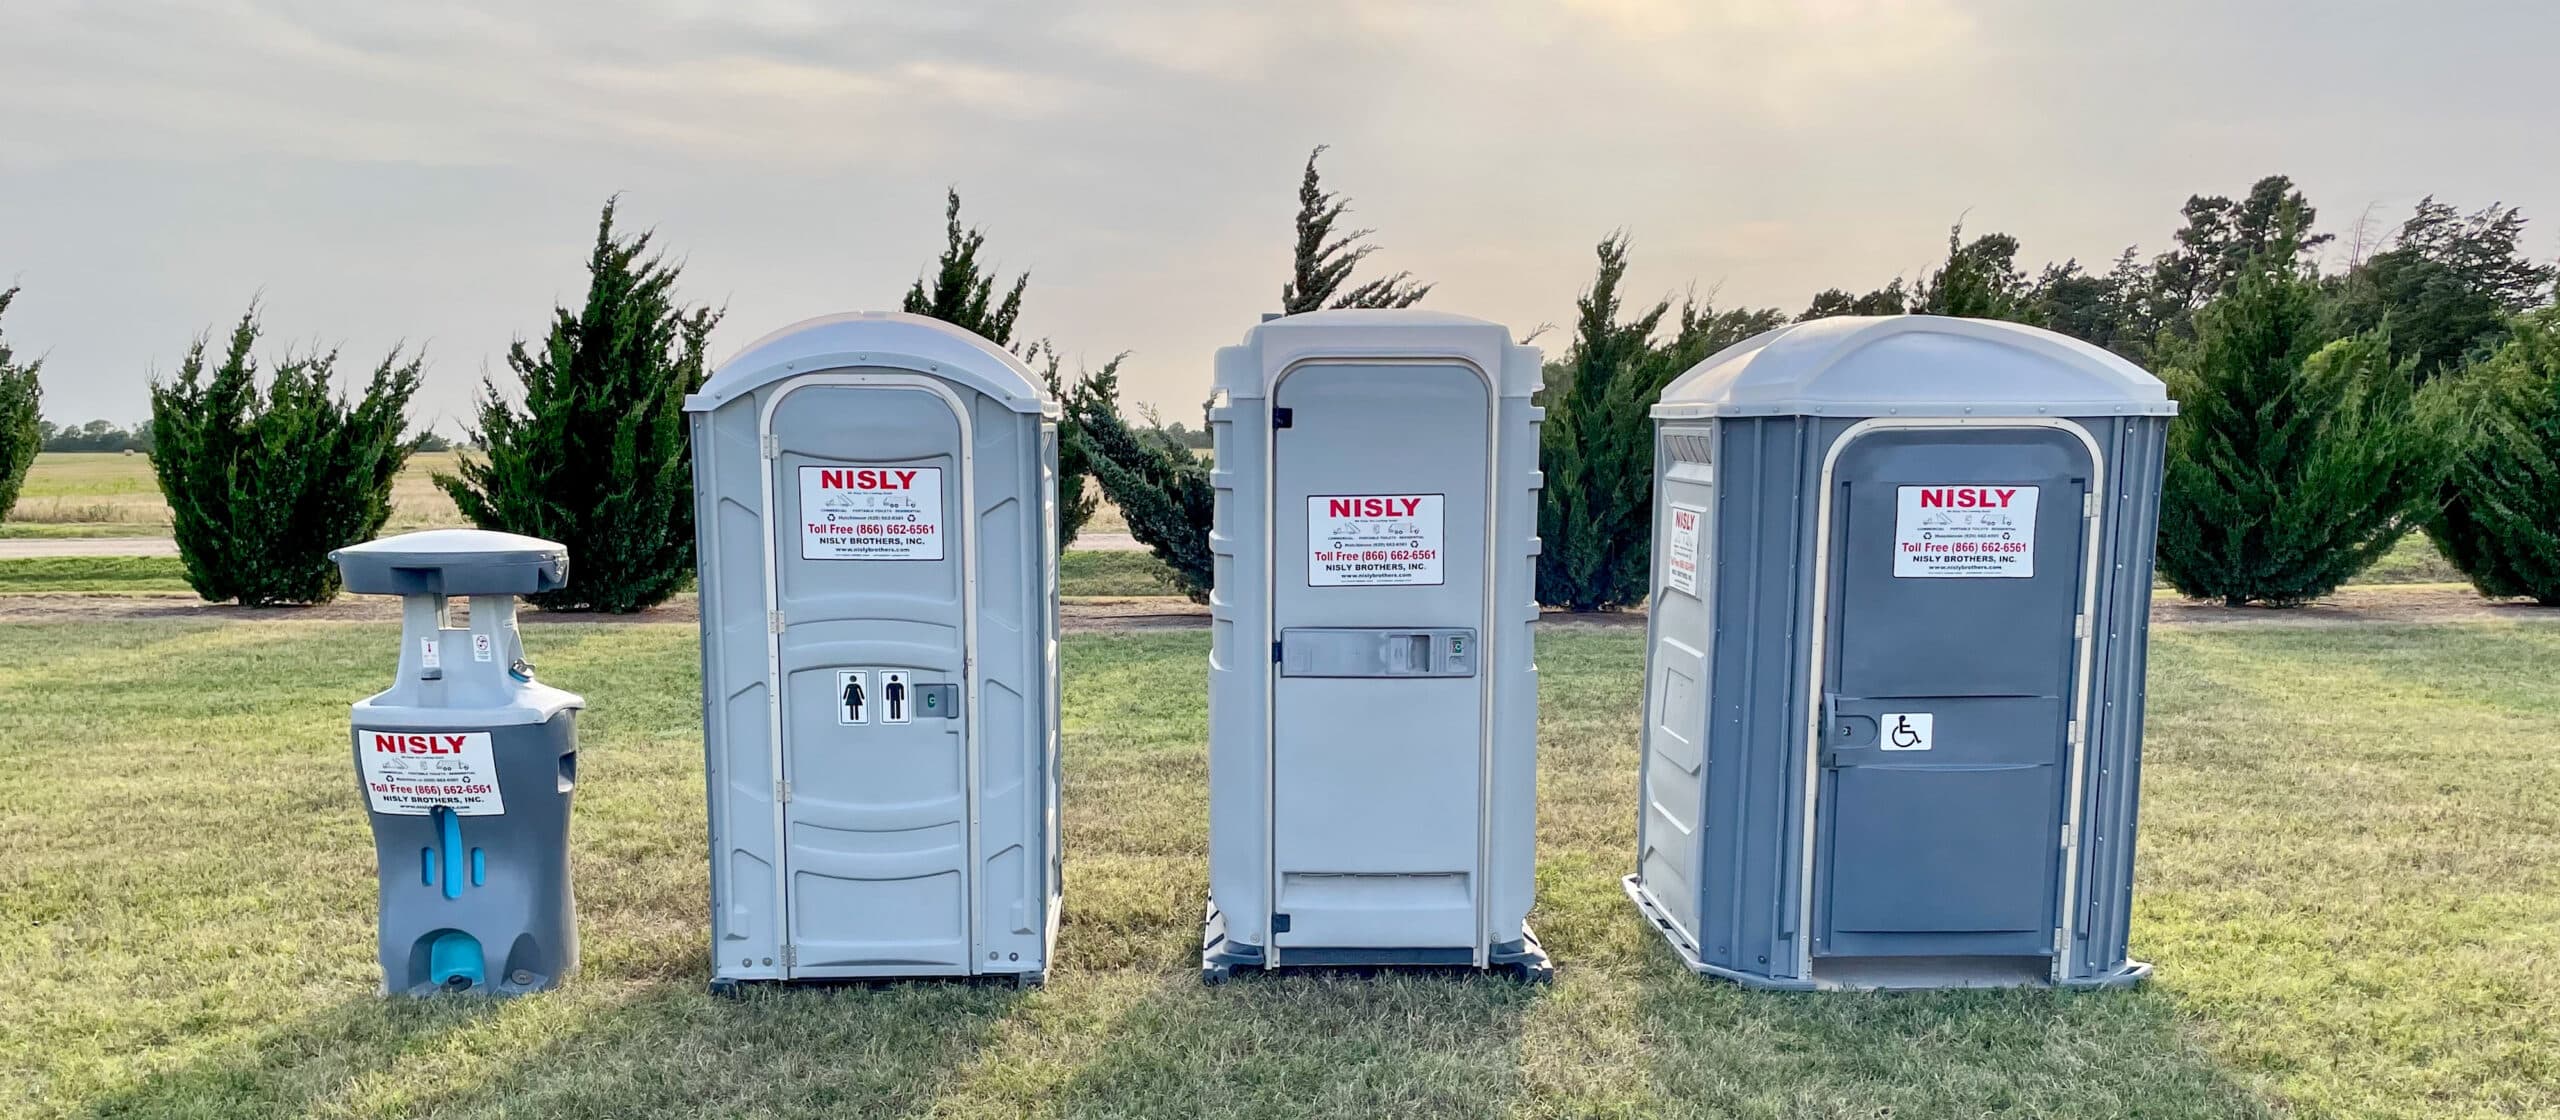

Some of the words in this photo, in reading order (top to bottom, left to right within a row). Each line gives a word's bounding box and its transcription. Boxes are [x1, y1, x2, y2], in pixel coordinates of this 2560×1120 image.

[821, 470, 917, 490] NISLY
[1921, 489, 2016, 508] NISLY
[1330, 498, 1421, 518] NISLY
[1676, 512, 1696, 530] NISLY
[808, 524, 826, 534] Toll
[830, 524, 853, 534] Free
[856, 524, 884, 536] (866)
[887, 524, 934, 534] 662-6561
[850, 538, 903, 546] BROTHERS,
[1902, 542, 1920, 552] Toll
[1925, 542, 1948, 552] Free
[1952, 542, 1978, 554] (866)
[1982, 542, 2026, 552] 662-6561
[1315, 552, 1332, 561] Toll
[1336, 552, 1358, 560] Free
[1362, 550, 1388, 562] (866)
[1390, 550, 1436, 560] 662-6561
[1944, 556, 1996, 564] BROTHERS,
[1355, 564, 1406, 572] BROTHERS,
[376, 735, 466, 754] NISLY
[370, 783, 388, 792] Toll
[391, 785, 412, 793] Free
[415, 785, 441, 795] (866)
[444, 784, 492, 794] 662-6561
[411, 796, 462, 804] BROTHERS,
